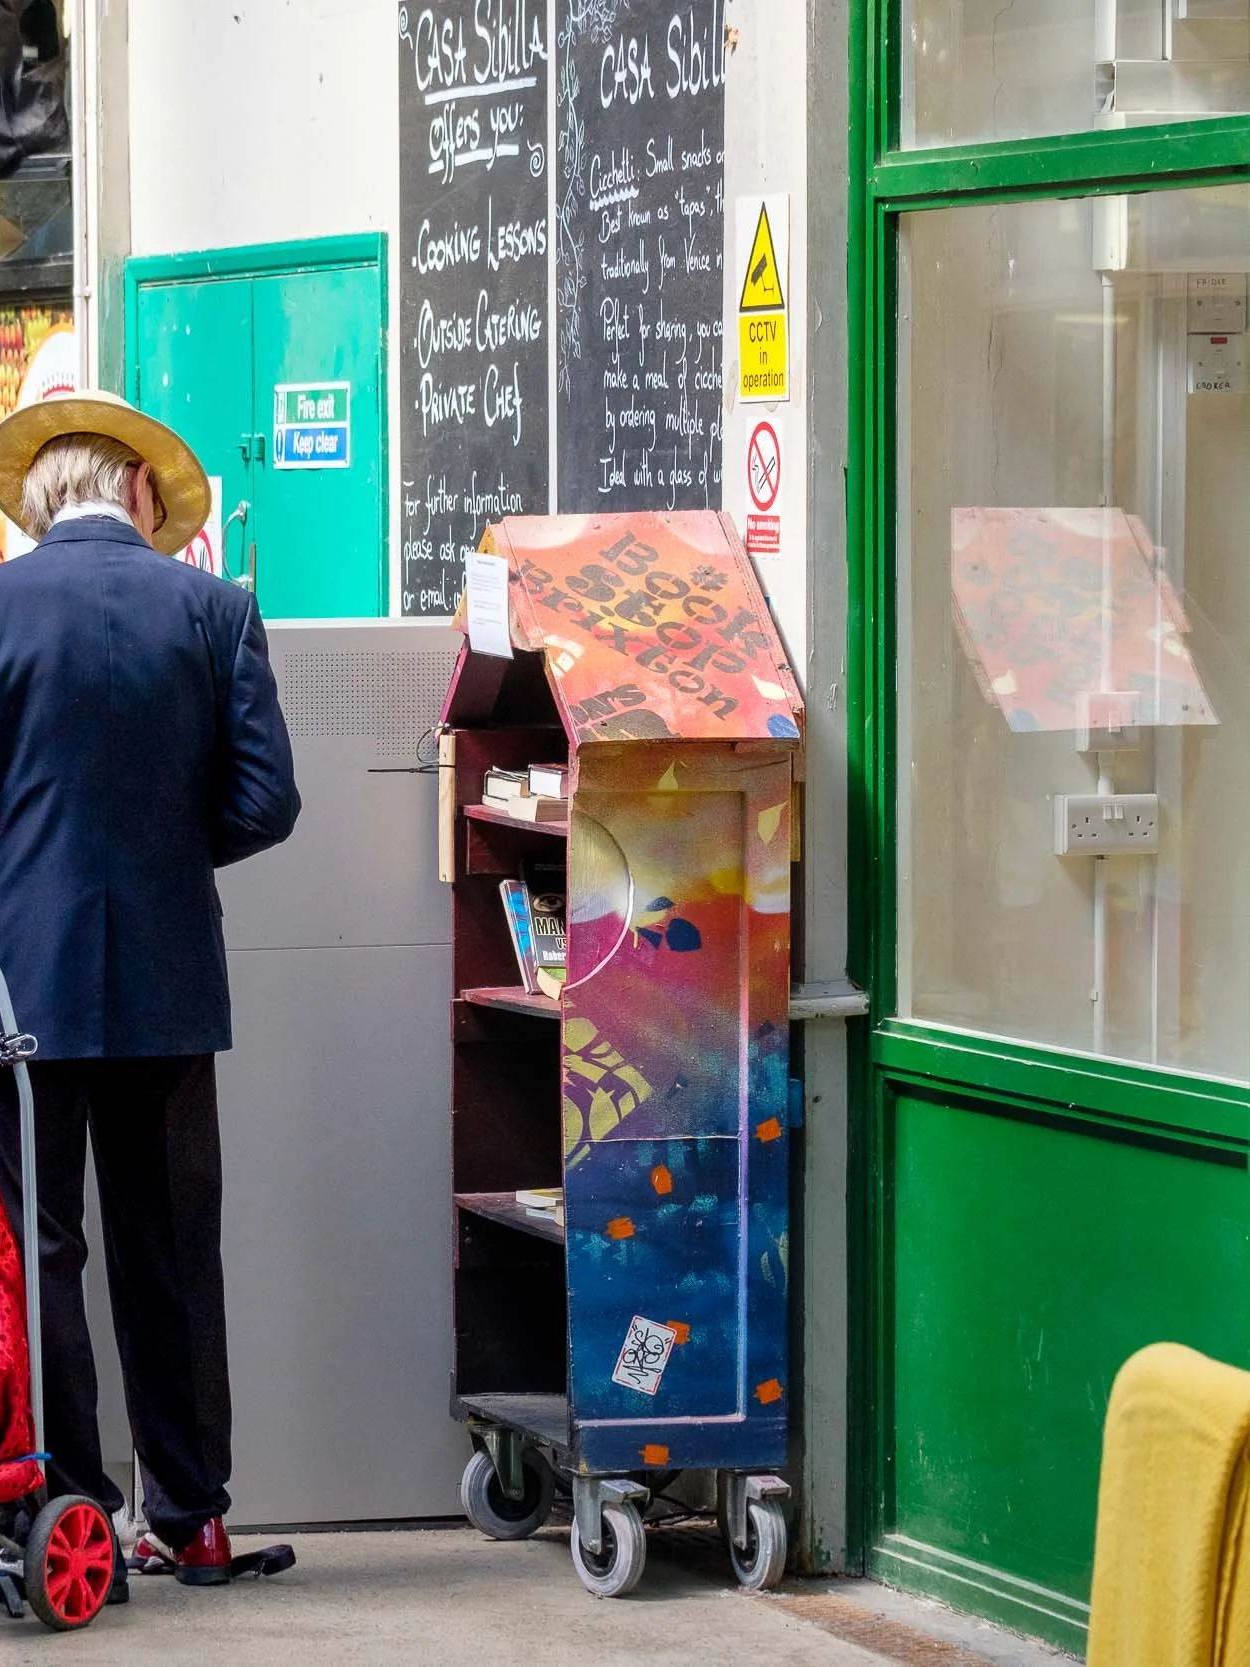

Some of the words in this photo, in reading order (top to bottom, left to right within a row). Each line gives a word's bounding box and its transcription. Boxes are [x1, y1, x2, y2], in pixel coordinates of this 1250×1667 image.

[415, 8, 467, 91] CASA
[600, 34, 655, 108] CASA
[429, 102, 481, 184] offers
[646, 134, 674, 177] Small
[681, 129, 712, 170] snacks
[598, 204, 623, 244] Best
[628, 200, 651, 227] known
[657, 205, 669, 220] as
[601, 238, 649, 294] traditionally
[658, 234, 676, 290] from
[684, 233, 711, 273] Venice
[600, 297, 630, 364] Perfect
[638, 303, 651, 367] for
[694, 320, 711, 364] you
[749, 320, 777, 342] CCTV
[759, 346, 768, 364] in
[603, 353, 628, 389] make
[632, 377, 640, 390] a
[645, 350, 669, 389] meal
[743, 368, 784, 392] operation
[297, 393, 316, 420] Fire
[317, 392, 335, 420] exit
[605, 396, 616, 453] by
[620, 394, 657, 452] ordering
[665, 394, 704, 460] multiple
[293, 431, 314, 459] Keep
[315, 430, 339, 454] clear
[598, 449, 626, 492] Ideal
[634, 447, 653, 487] with
[657, 469, 664, 486] a
[667, 445, 692, 510] glass
[698, 450, 709, 509] of
[423, 475, 458, 536] further
[463, 470, 523, 540] information
[404, 525, 433, 584] please
[440, 524, 455, 562] ask
[403, 589, 414, 611] or
